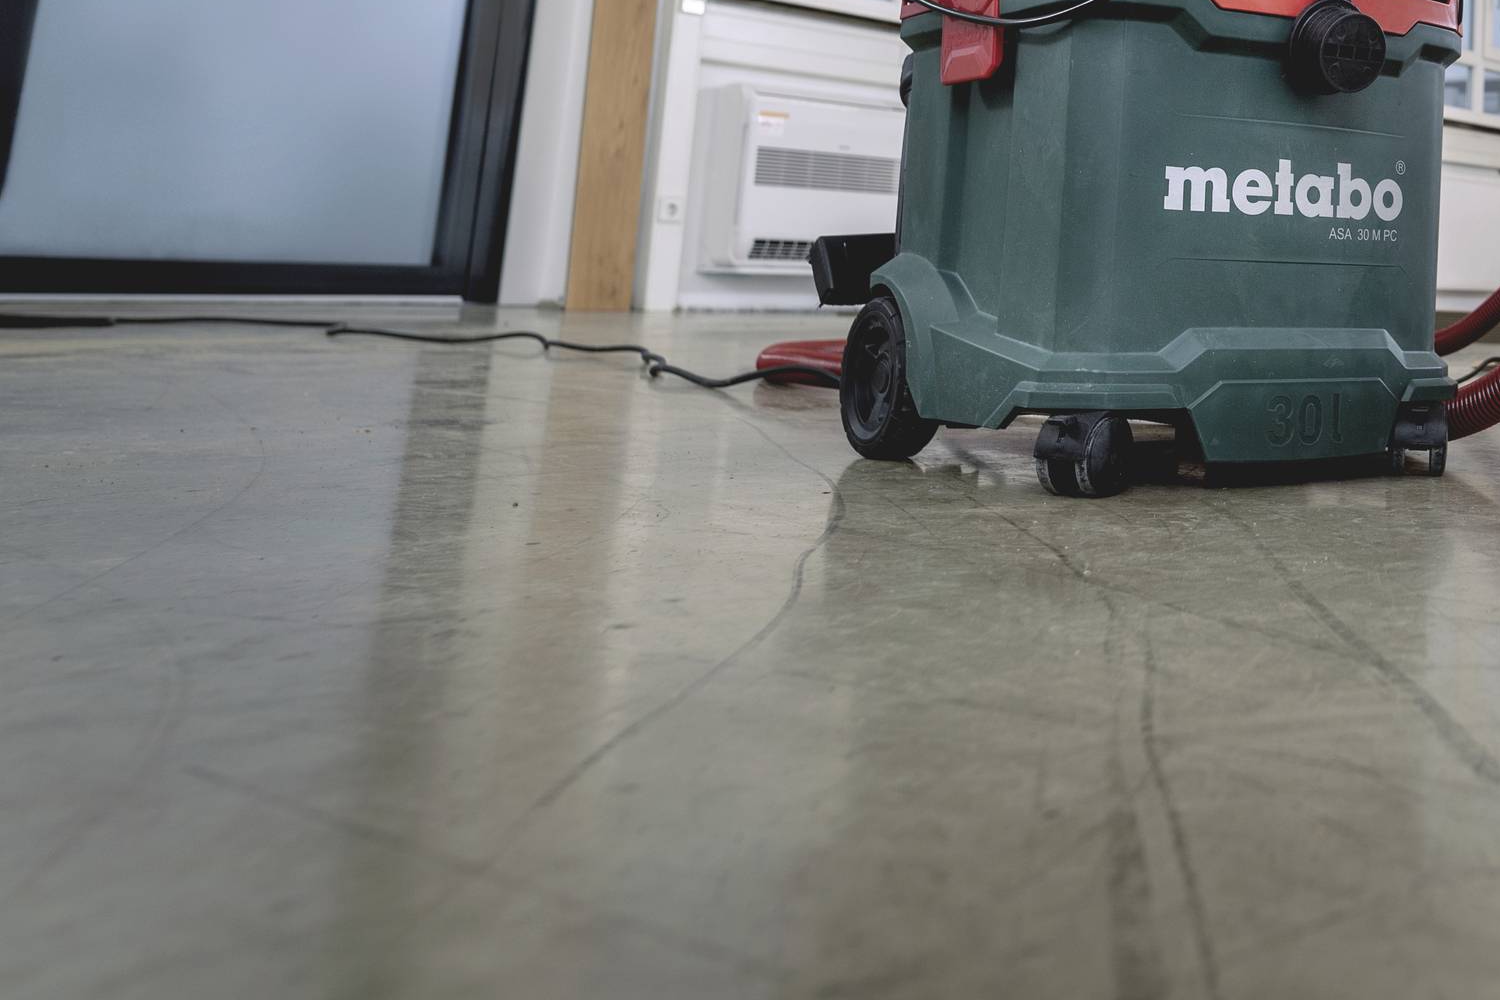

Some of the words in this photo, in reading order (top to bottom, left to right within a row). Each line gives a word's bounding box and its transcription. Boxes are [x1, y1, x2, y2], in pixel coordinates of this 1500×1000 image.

[1163, 158, 1404, 222] metabo
[1328, 227, 1353, 240] ASA
[1357, 228, 1370, 241] 30
[1372, 229, 1381, 241] M
[1383, 229, 1398, 242] PC
